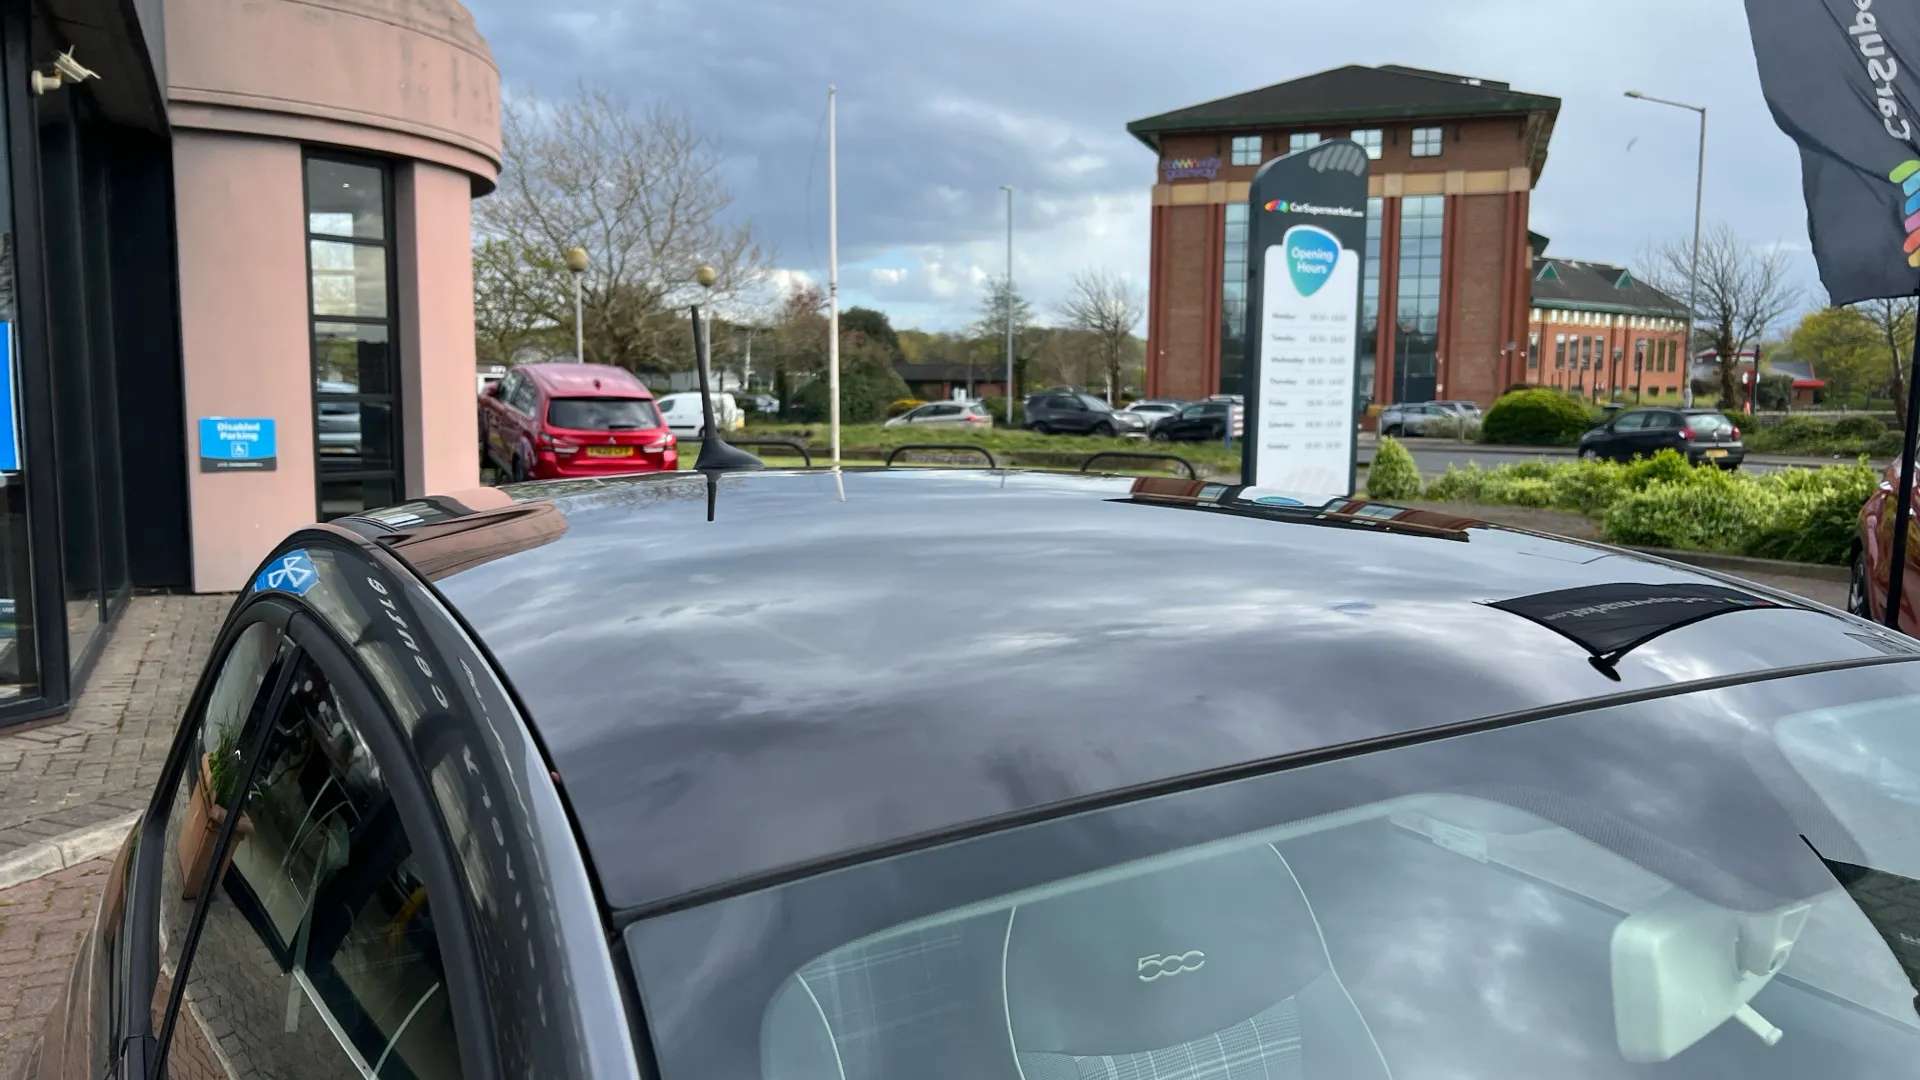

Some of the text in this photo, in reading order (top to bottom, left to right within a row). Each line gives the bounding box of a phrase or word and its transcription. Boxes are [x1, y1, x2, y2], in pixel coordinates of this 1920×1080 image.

[1291, 247, 1334, 263] Opening
[1297, 263, 1327, 274] Hours
[217, 422, 260, 432] Disabled
[220, 432, 259, 442] Parking
